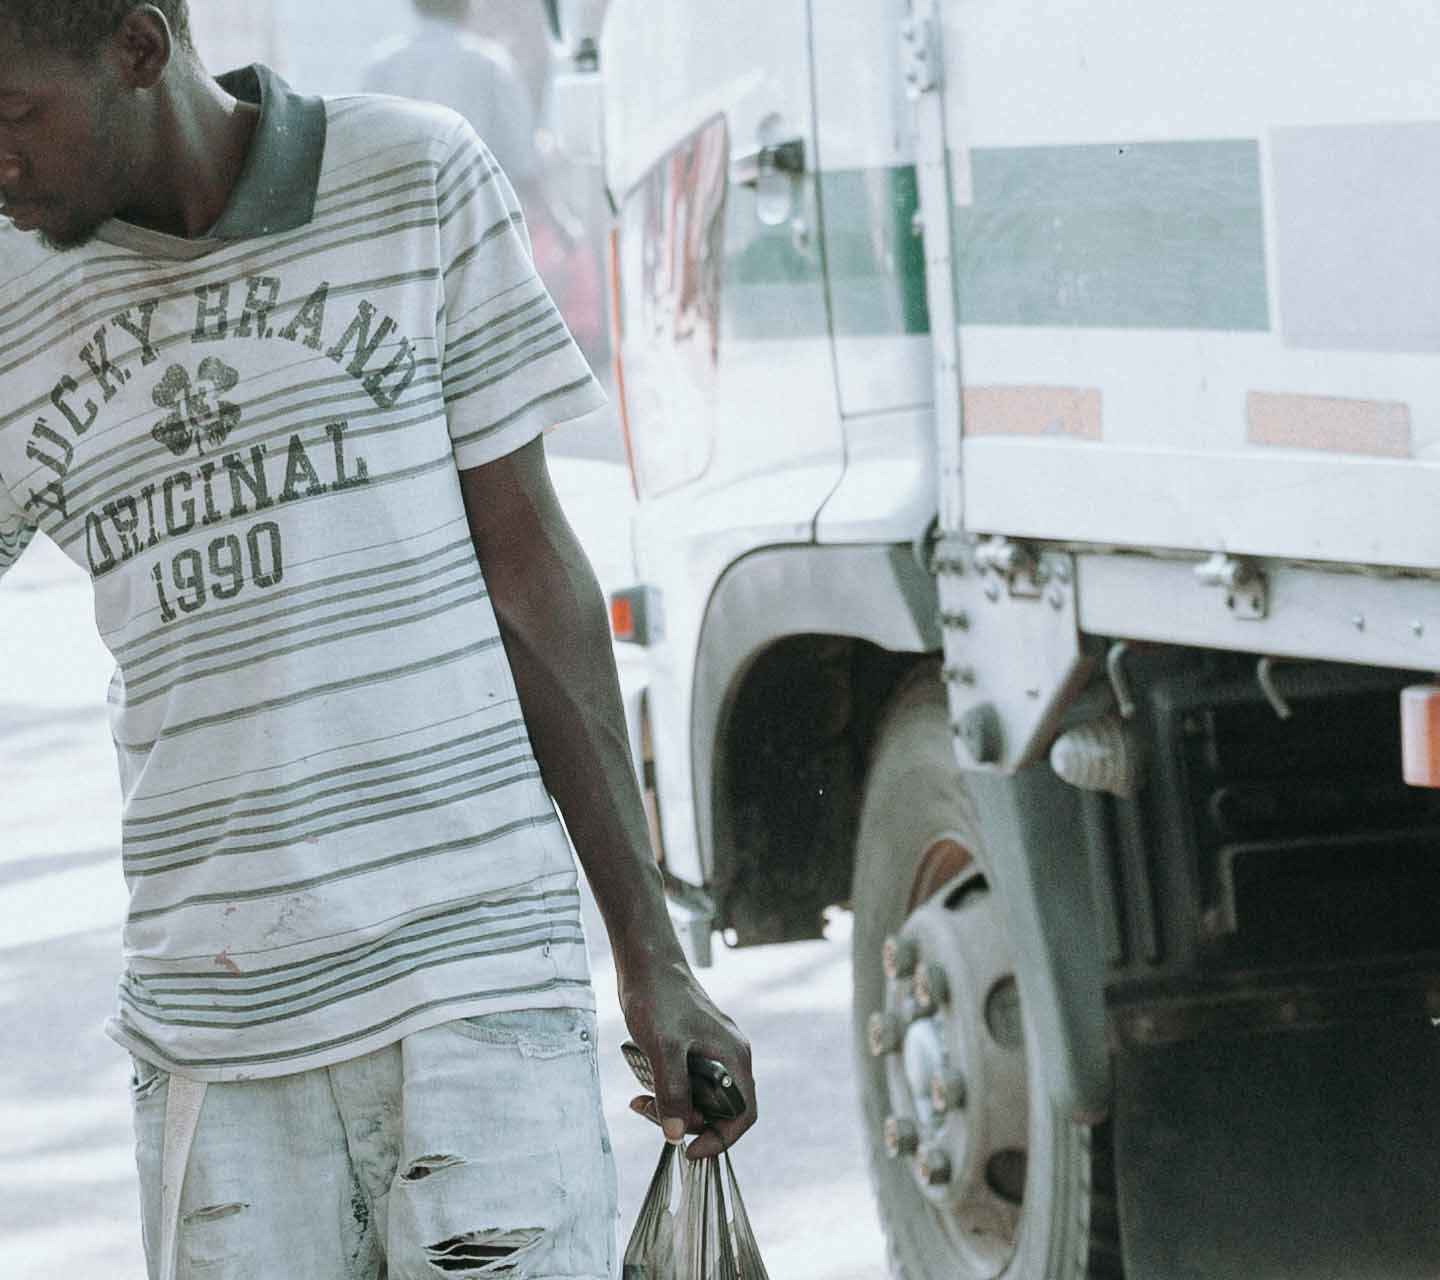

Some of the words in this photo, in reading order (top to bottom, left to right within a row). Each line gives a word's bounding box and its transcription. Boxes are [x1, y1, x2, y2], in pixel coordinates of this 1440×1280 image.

[190, 274, 418, 410] BRAND
[84, 419, 371, 578] ORIGINAL
[150, 519, 285, 624] 1990
